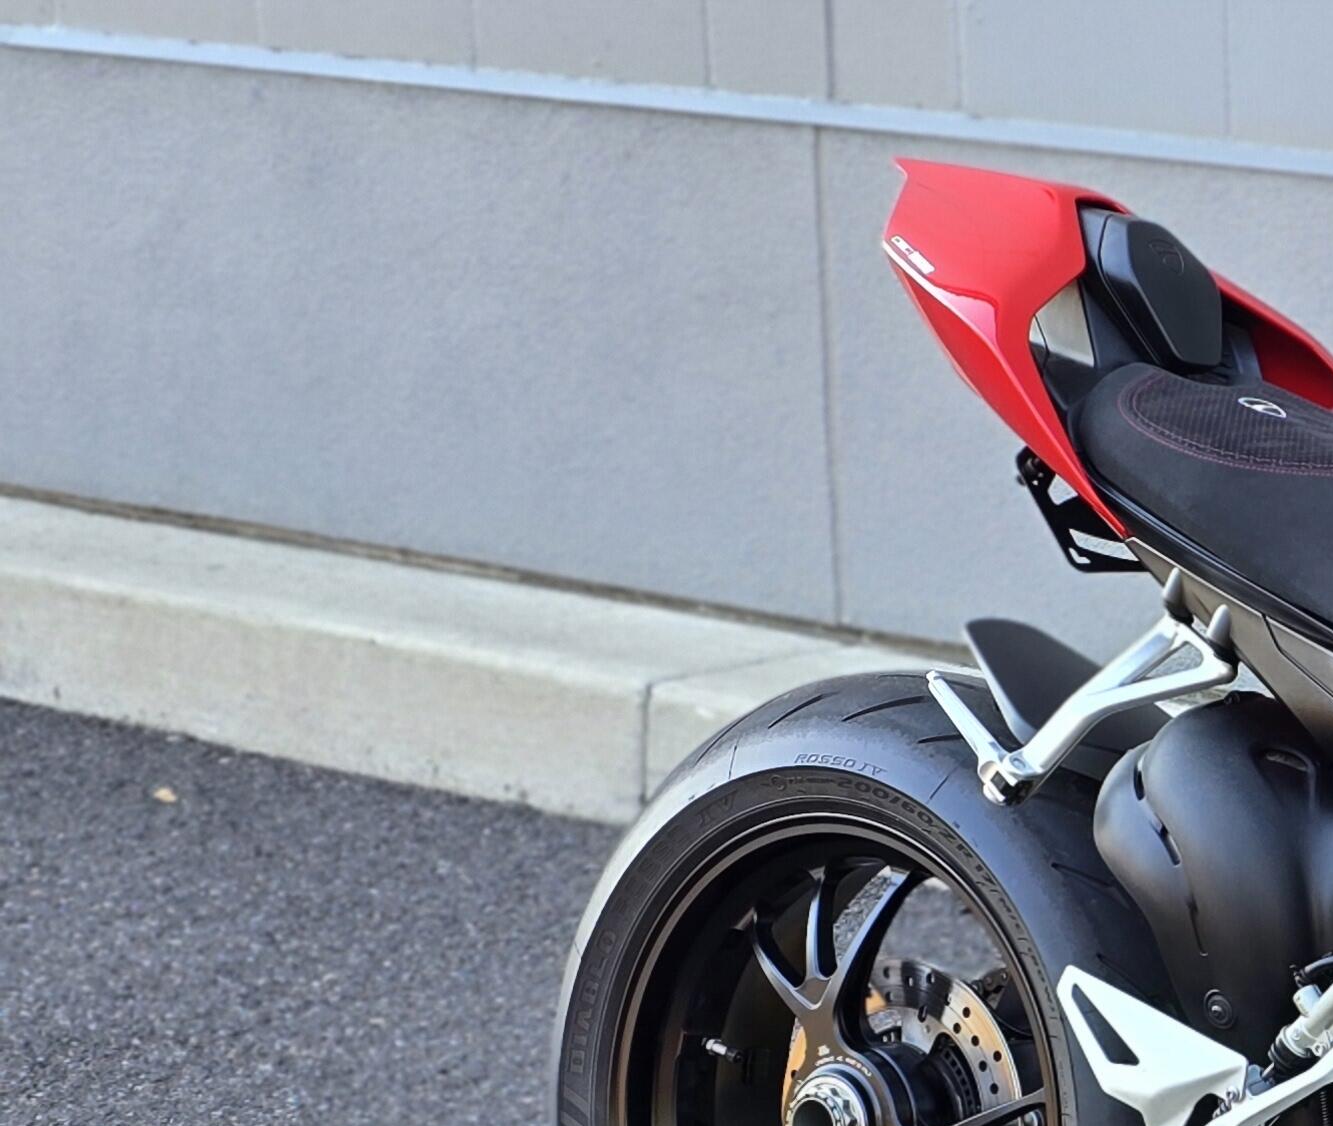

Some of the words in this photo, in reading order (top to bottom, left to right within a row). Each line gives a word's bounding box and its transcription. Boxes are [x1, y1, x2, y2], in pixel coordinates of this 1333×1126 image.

[793, 753, 857, 769] ROSSO
[857, 761, 888, 776] IV
[568, 928, 618, 1074] DIABLO
